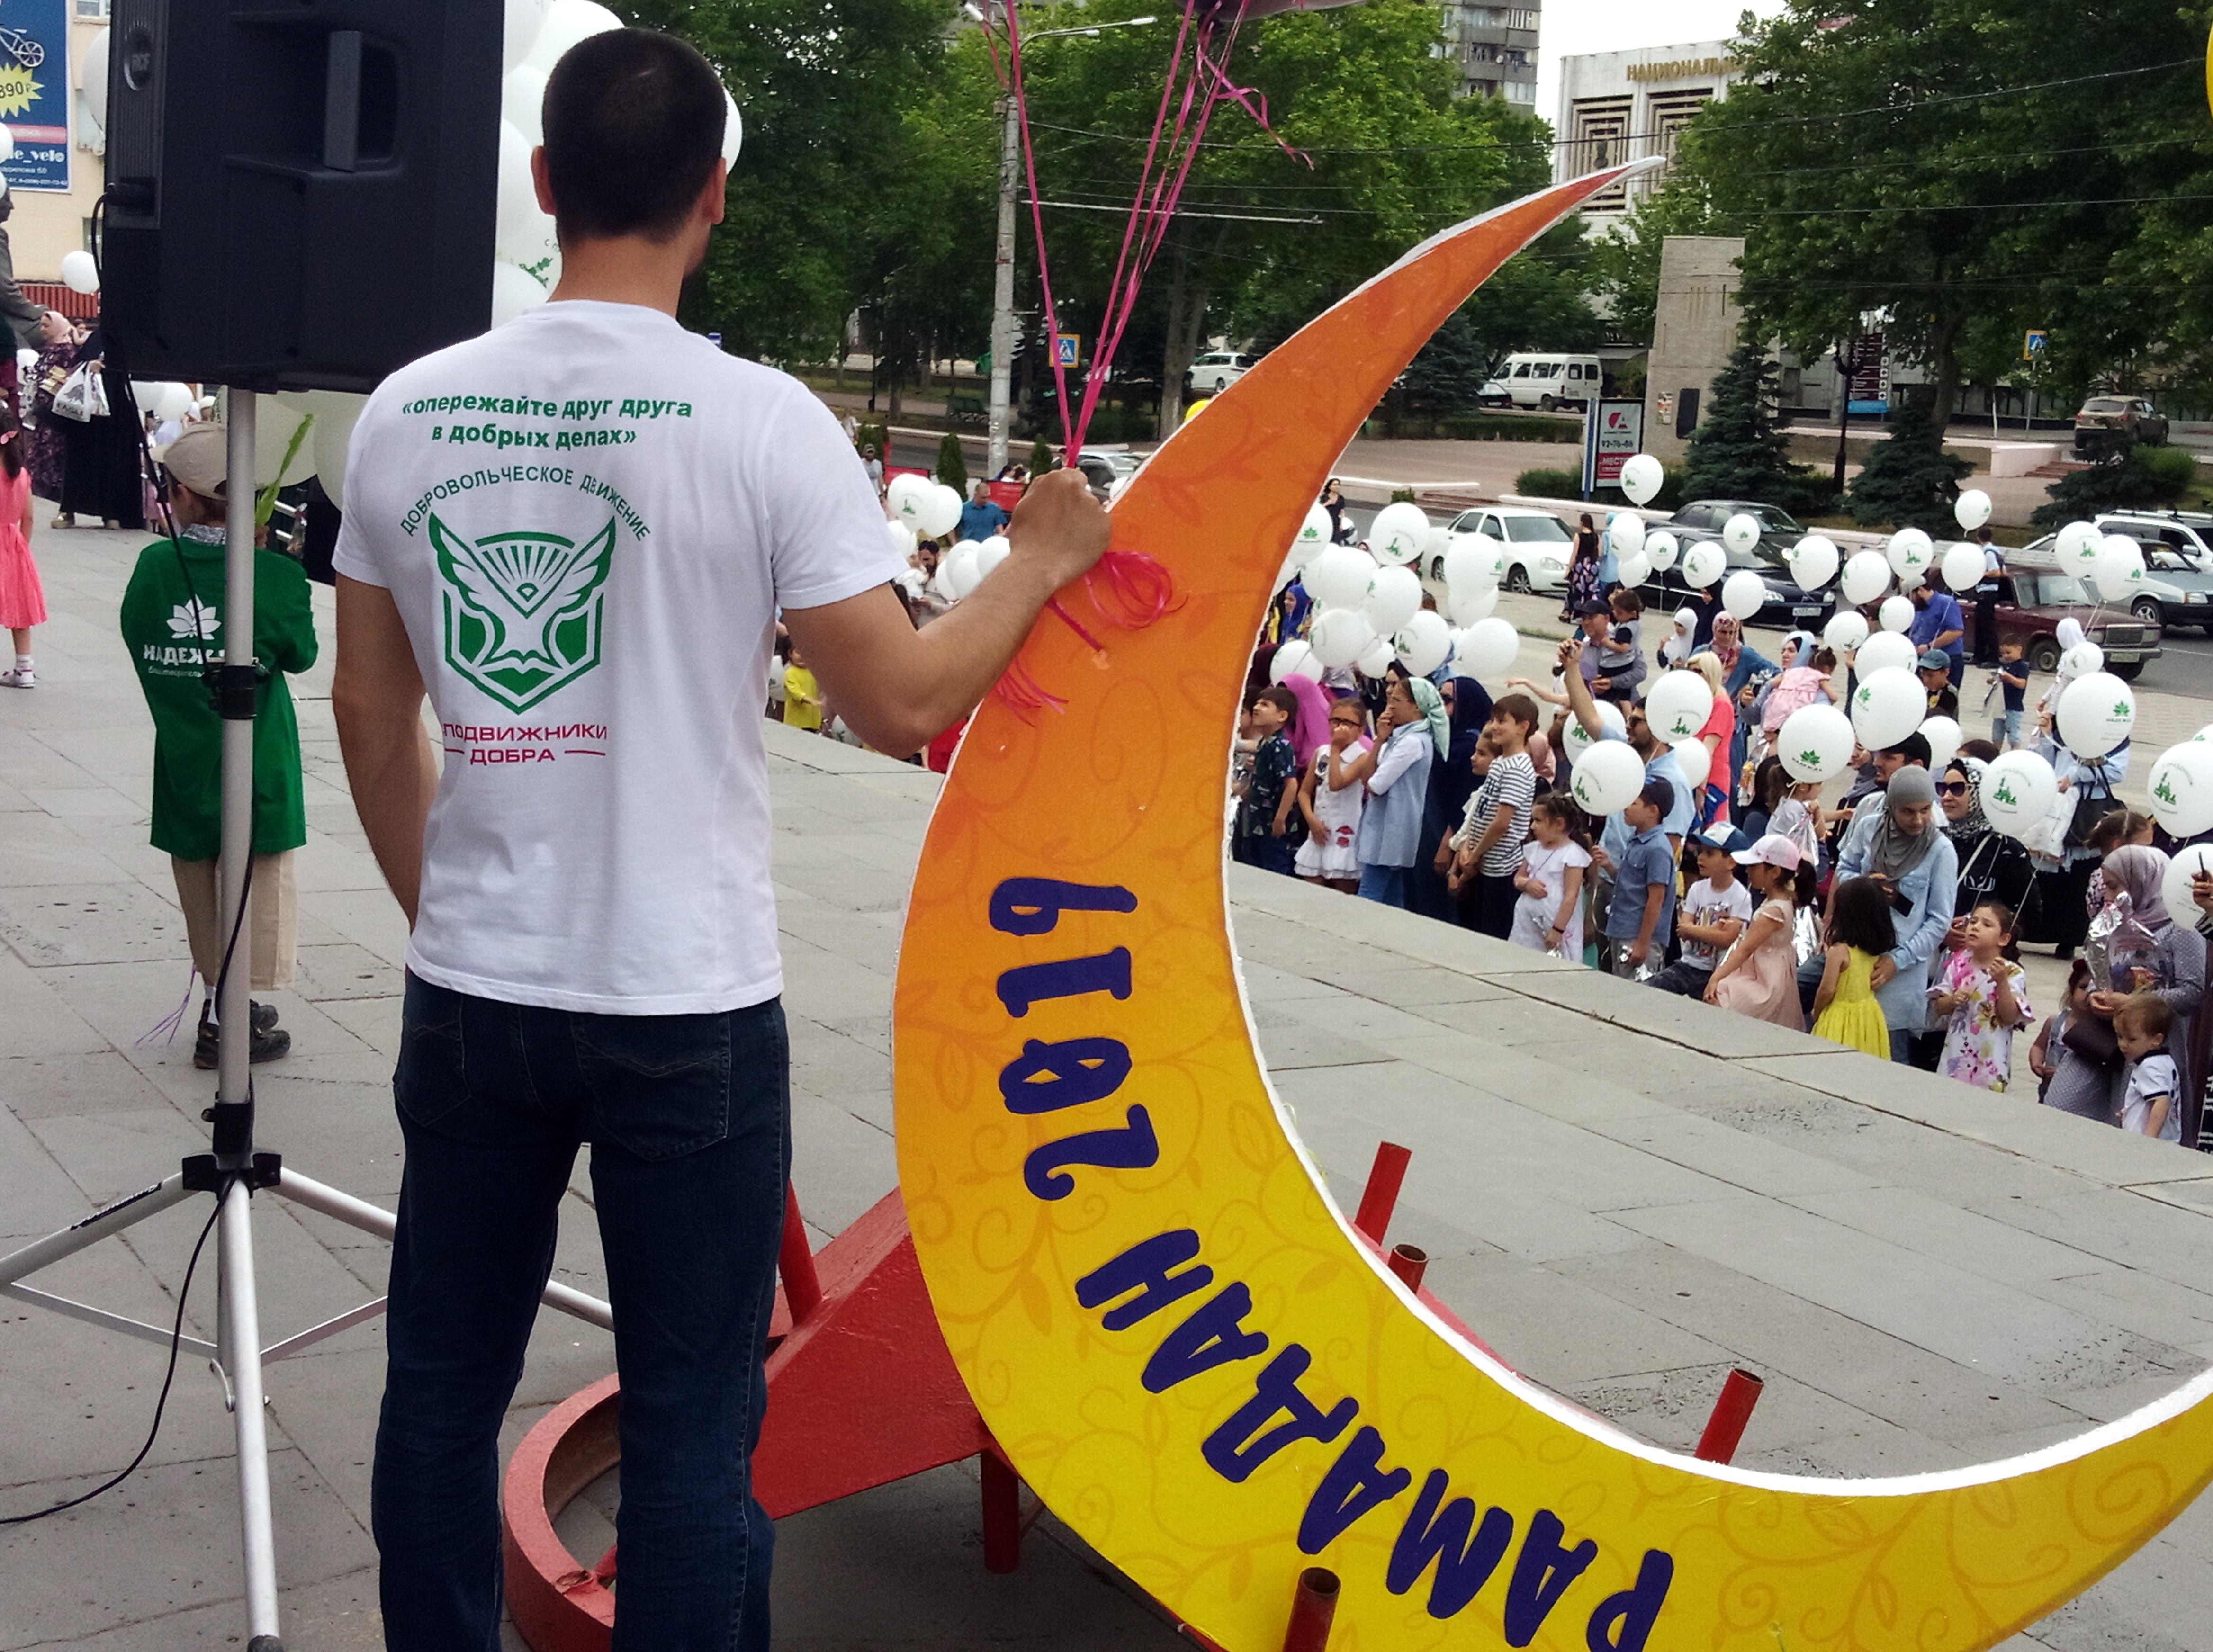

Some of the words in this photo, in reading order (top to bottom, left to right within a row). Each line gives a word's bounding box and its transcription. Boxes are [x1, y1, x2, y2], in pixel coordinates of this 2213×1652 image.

[8, 150, 65, 163] e_velo
[403, 395, 558, 417] «опережайте
[562, 399, 613, 421] друг
[619, 399, 692, 419] друга
[432, 426, 443, 440] в
[449, 423, 550, 450] добрых
[555, 430, 637, 451] делах»
[400, 466, 574, 537] ДОБРОВОЛЬЧЕСКОЕ
[578, 474, 651, 541] ДВИЖЕНИЕ
[443, 723, 607, 744] ПОДВИЖНИКИ
[470, 748, 556, 766] ДОБРА
[989, 876, 1159, 1201] 2019
[1075, 1228, 1673, 1652] РАМАДАН
